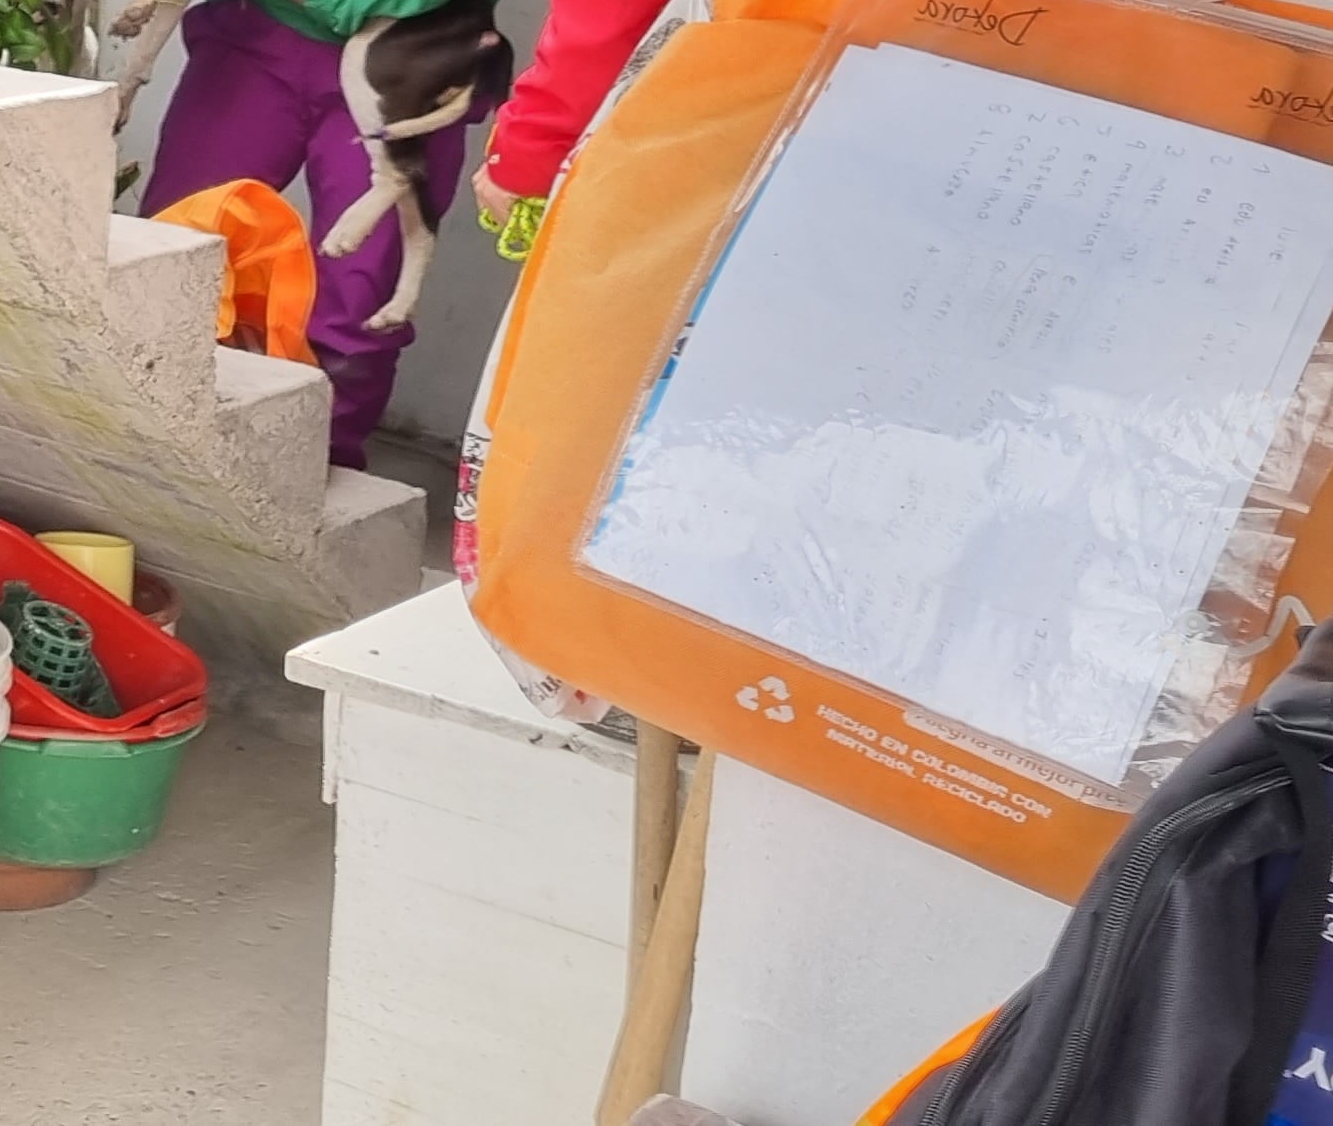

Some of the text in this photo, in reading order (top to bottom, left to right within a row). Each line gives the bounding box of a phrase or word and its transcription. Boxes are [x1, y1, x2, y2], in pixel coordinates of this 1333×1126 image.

[816, 704, 1054, 818] HECHO EN COLOMBIA CON
[825, 728, 1027, 824] MATERIAL RECICLADO
